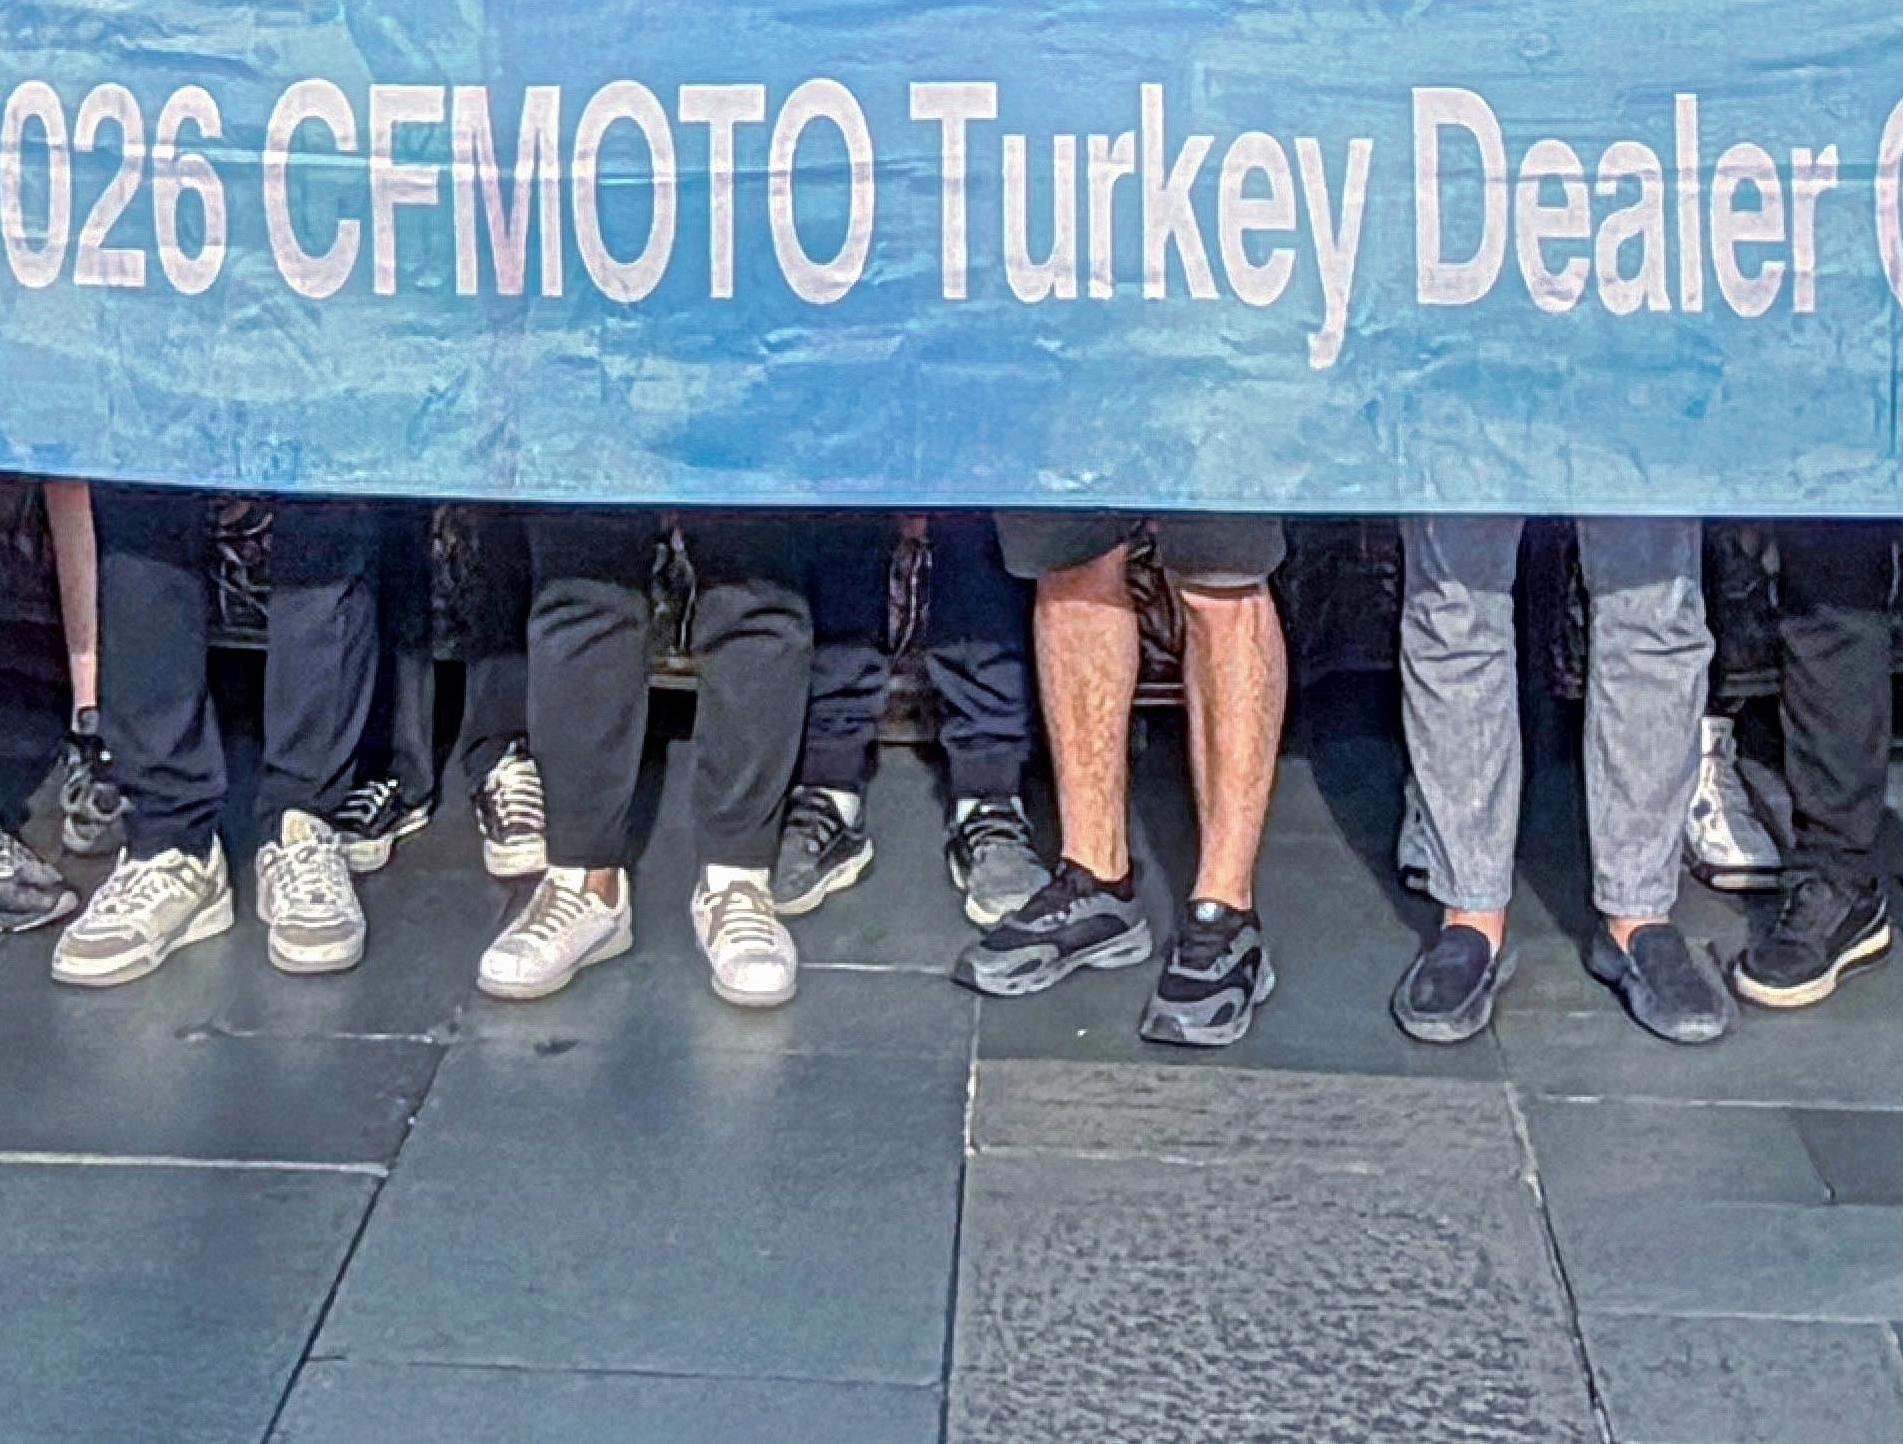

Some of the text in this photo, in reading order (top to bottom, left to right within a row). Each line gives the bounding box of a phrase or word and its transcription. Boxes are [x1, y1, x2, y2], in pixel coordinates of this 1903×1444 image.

[263, 78, 875, 305] CFMOTO
[909, 82, 1374, 370] Turkey
[1410, 86, 1838, 318] Dealer
